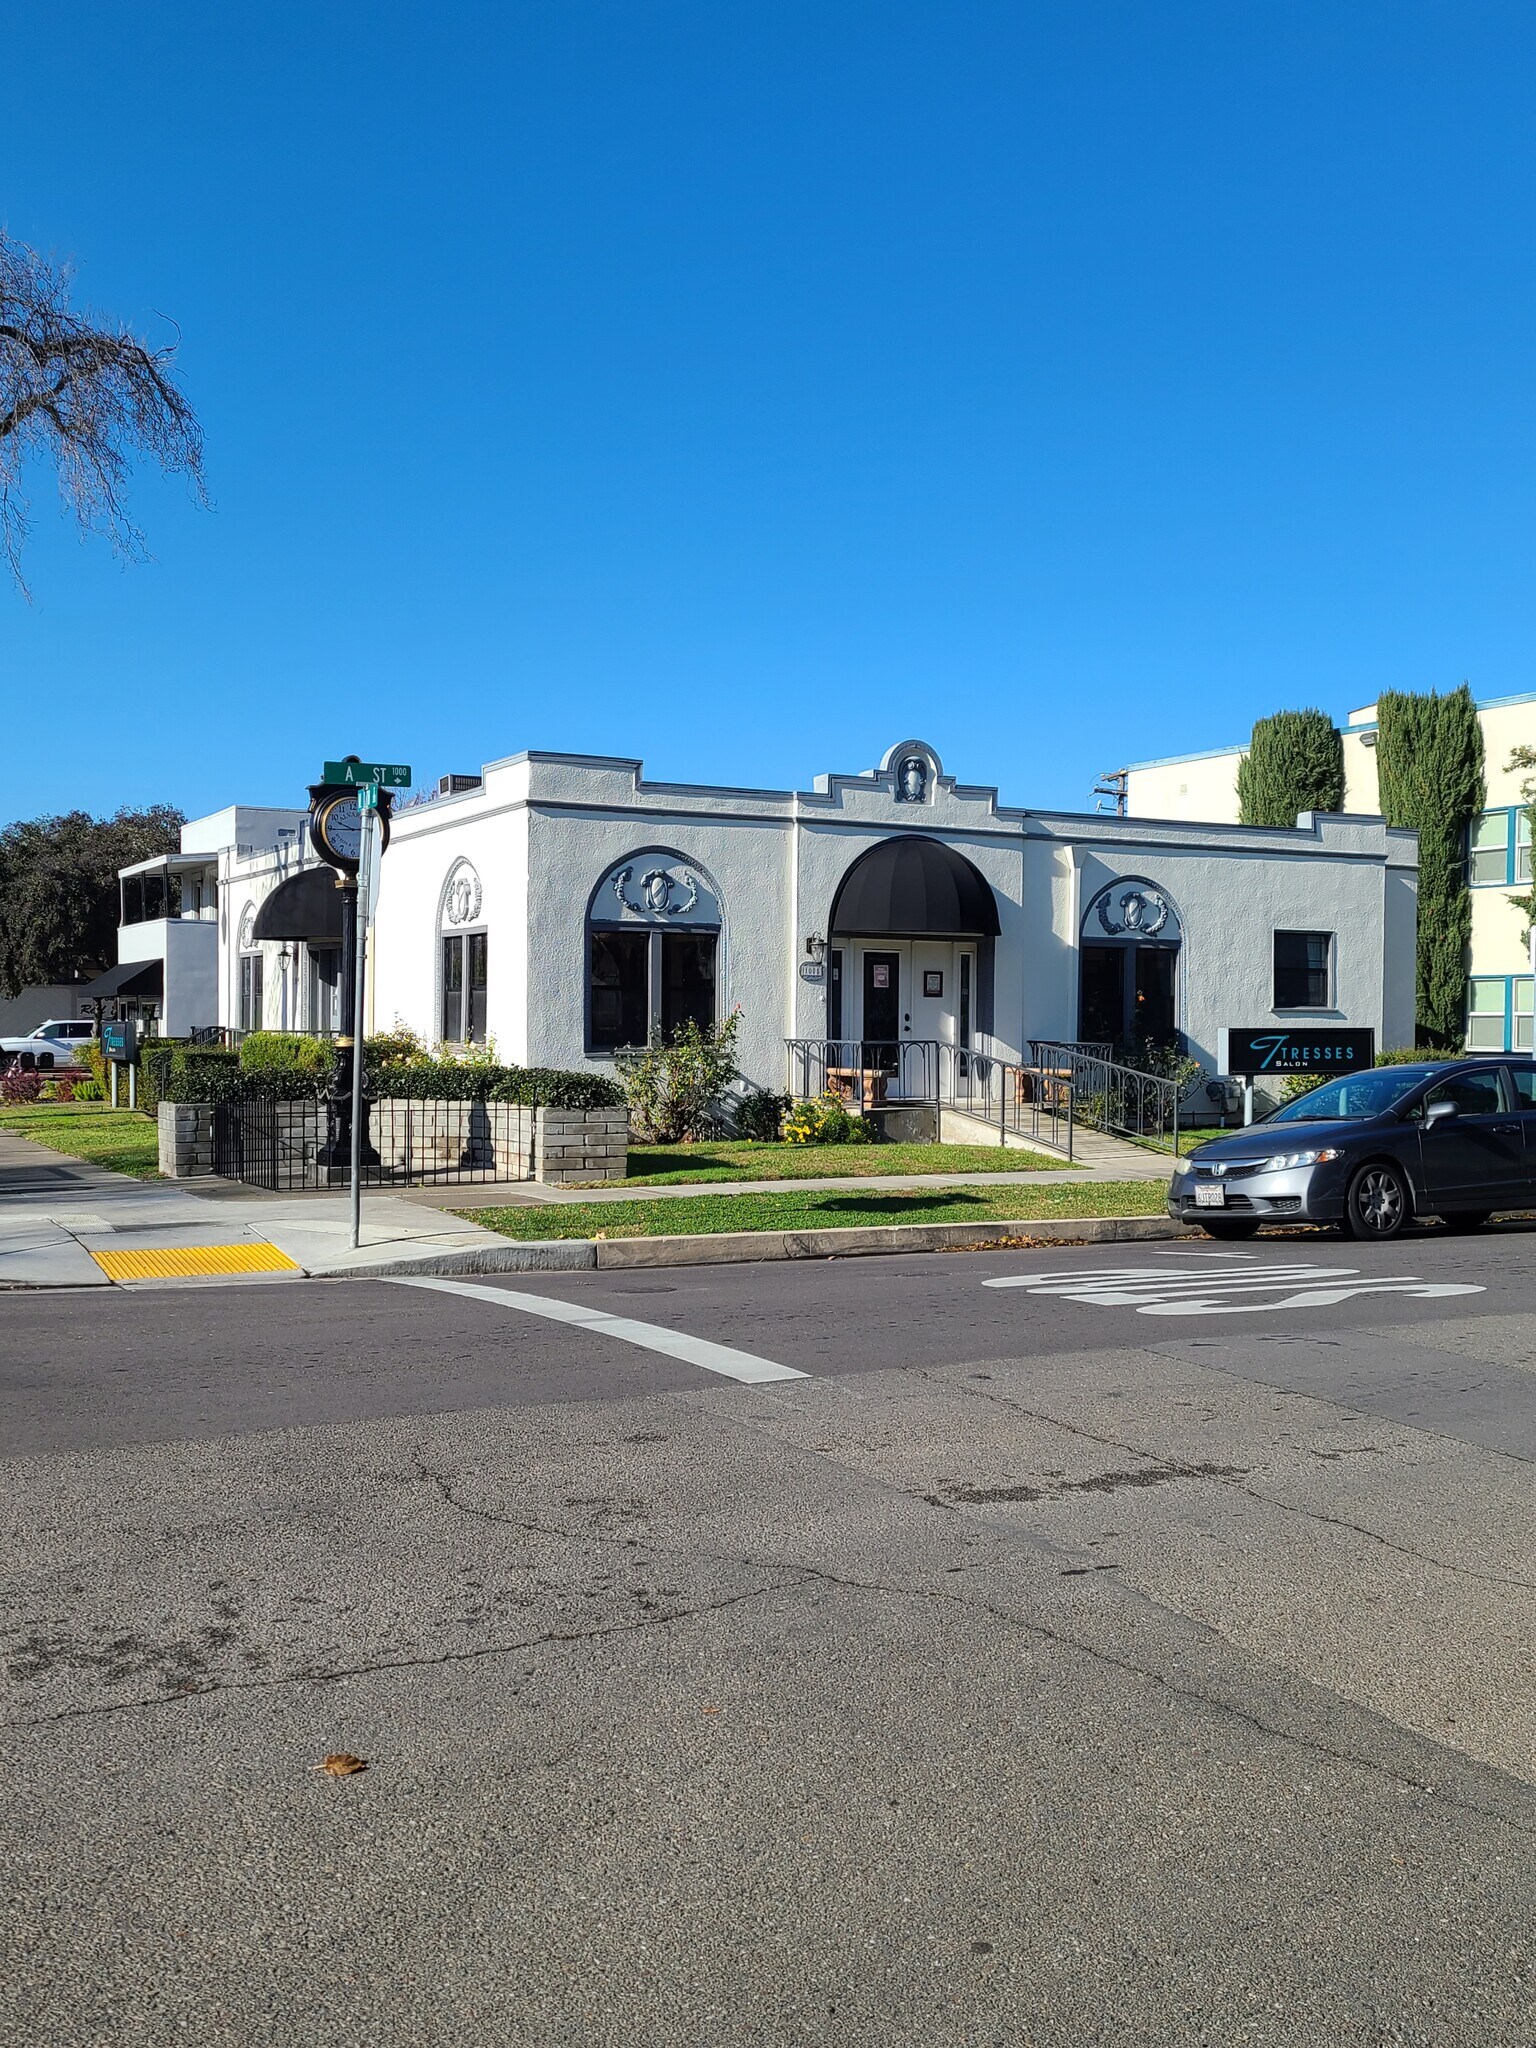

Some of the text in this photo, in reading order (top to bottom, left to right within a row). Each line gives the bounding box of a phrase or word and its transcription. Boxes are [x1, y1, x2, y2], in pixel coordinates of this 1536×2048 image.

[345, 766, 407, 783] A ST 1000
[1281, 1047, 1354, 1060] TRESSES
